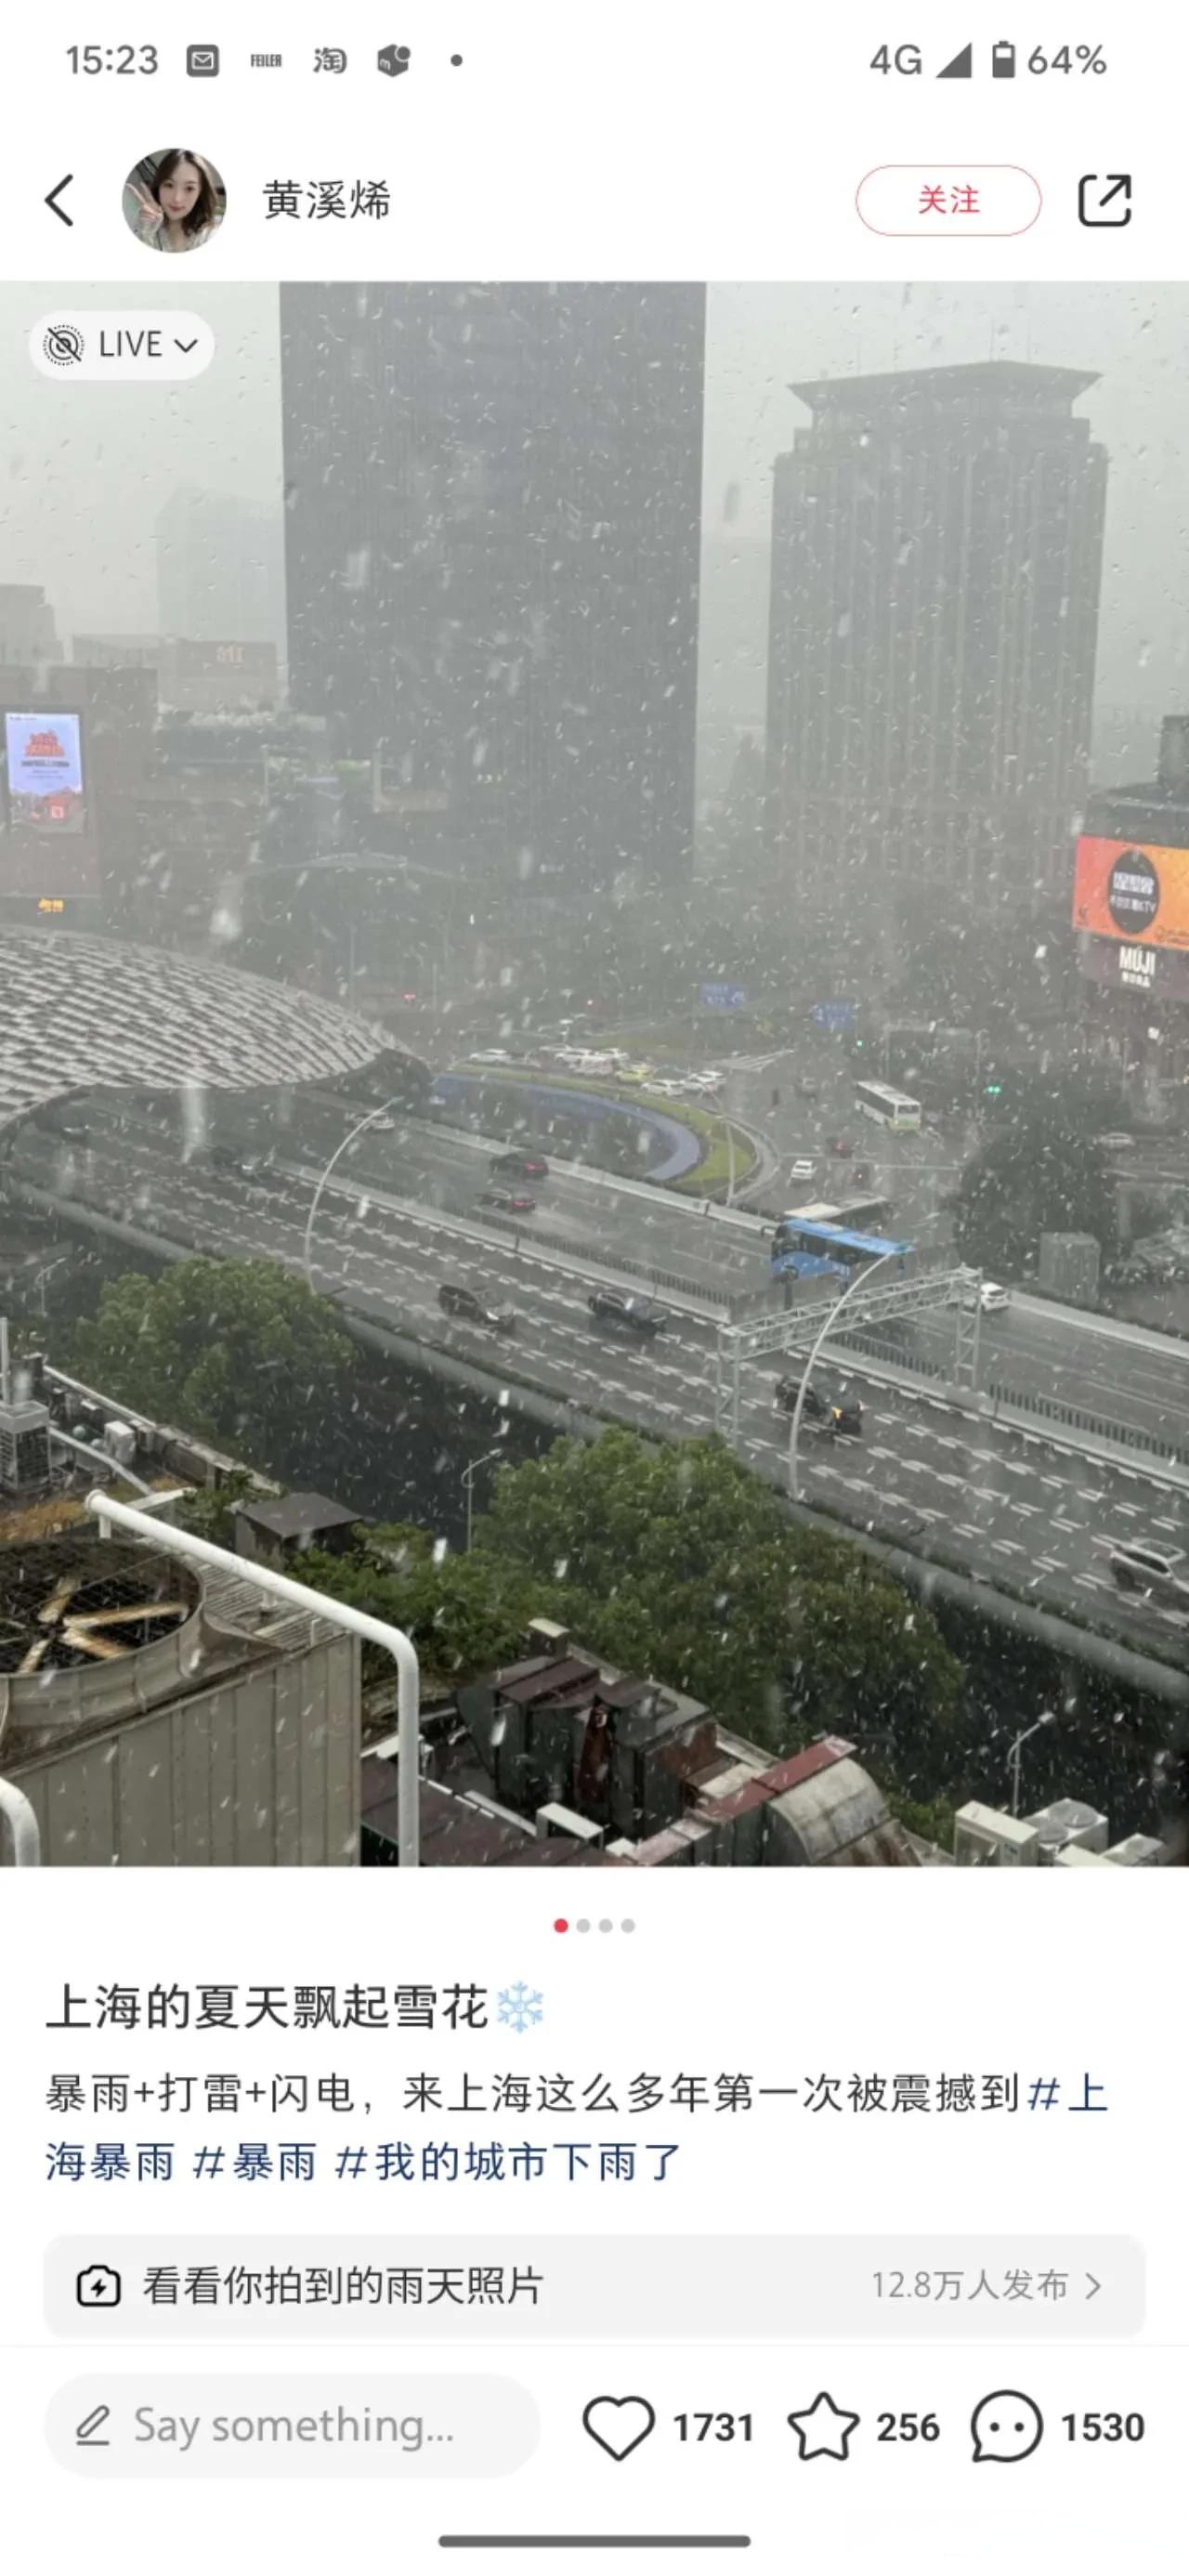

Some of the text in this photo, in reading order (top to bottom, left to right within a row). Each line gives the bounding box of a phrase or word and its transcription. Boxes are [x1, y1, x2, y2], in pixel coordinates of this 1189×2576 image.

[66, 45, 159, 75] 15:23
[250, 53, 282, 69] FEILER
[312, 46, 347, 74] 淘
[869, 44, 922, 75] 4G
[1027, 45, 1107, 75] 64%
[262, 179, 391, 220] 黄溪烯
[918, 183, 981, 215] 关注
[1119, 946, 1156, 975] MUJI
[46, 1982, 489, 2031] 上海的夏天飘起雪花
[46, 2140, 681, 2182] 海暴雨 #暴雨 #我的城市下雨了
[143, 2265, 544, 2307] 看看你拍到的雨天照片
[873, 2269, 1069, 2301] 12.8万人发布
[135, 2405, 454, 2452] Say something...
[673, 2412, 753, 2442] 1731
[877, 2412, 941, 2442] 256
[1062, 2412, 1145, 2442] 1530
